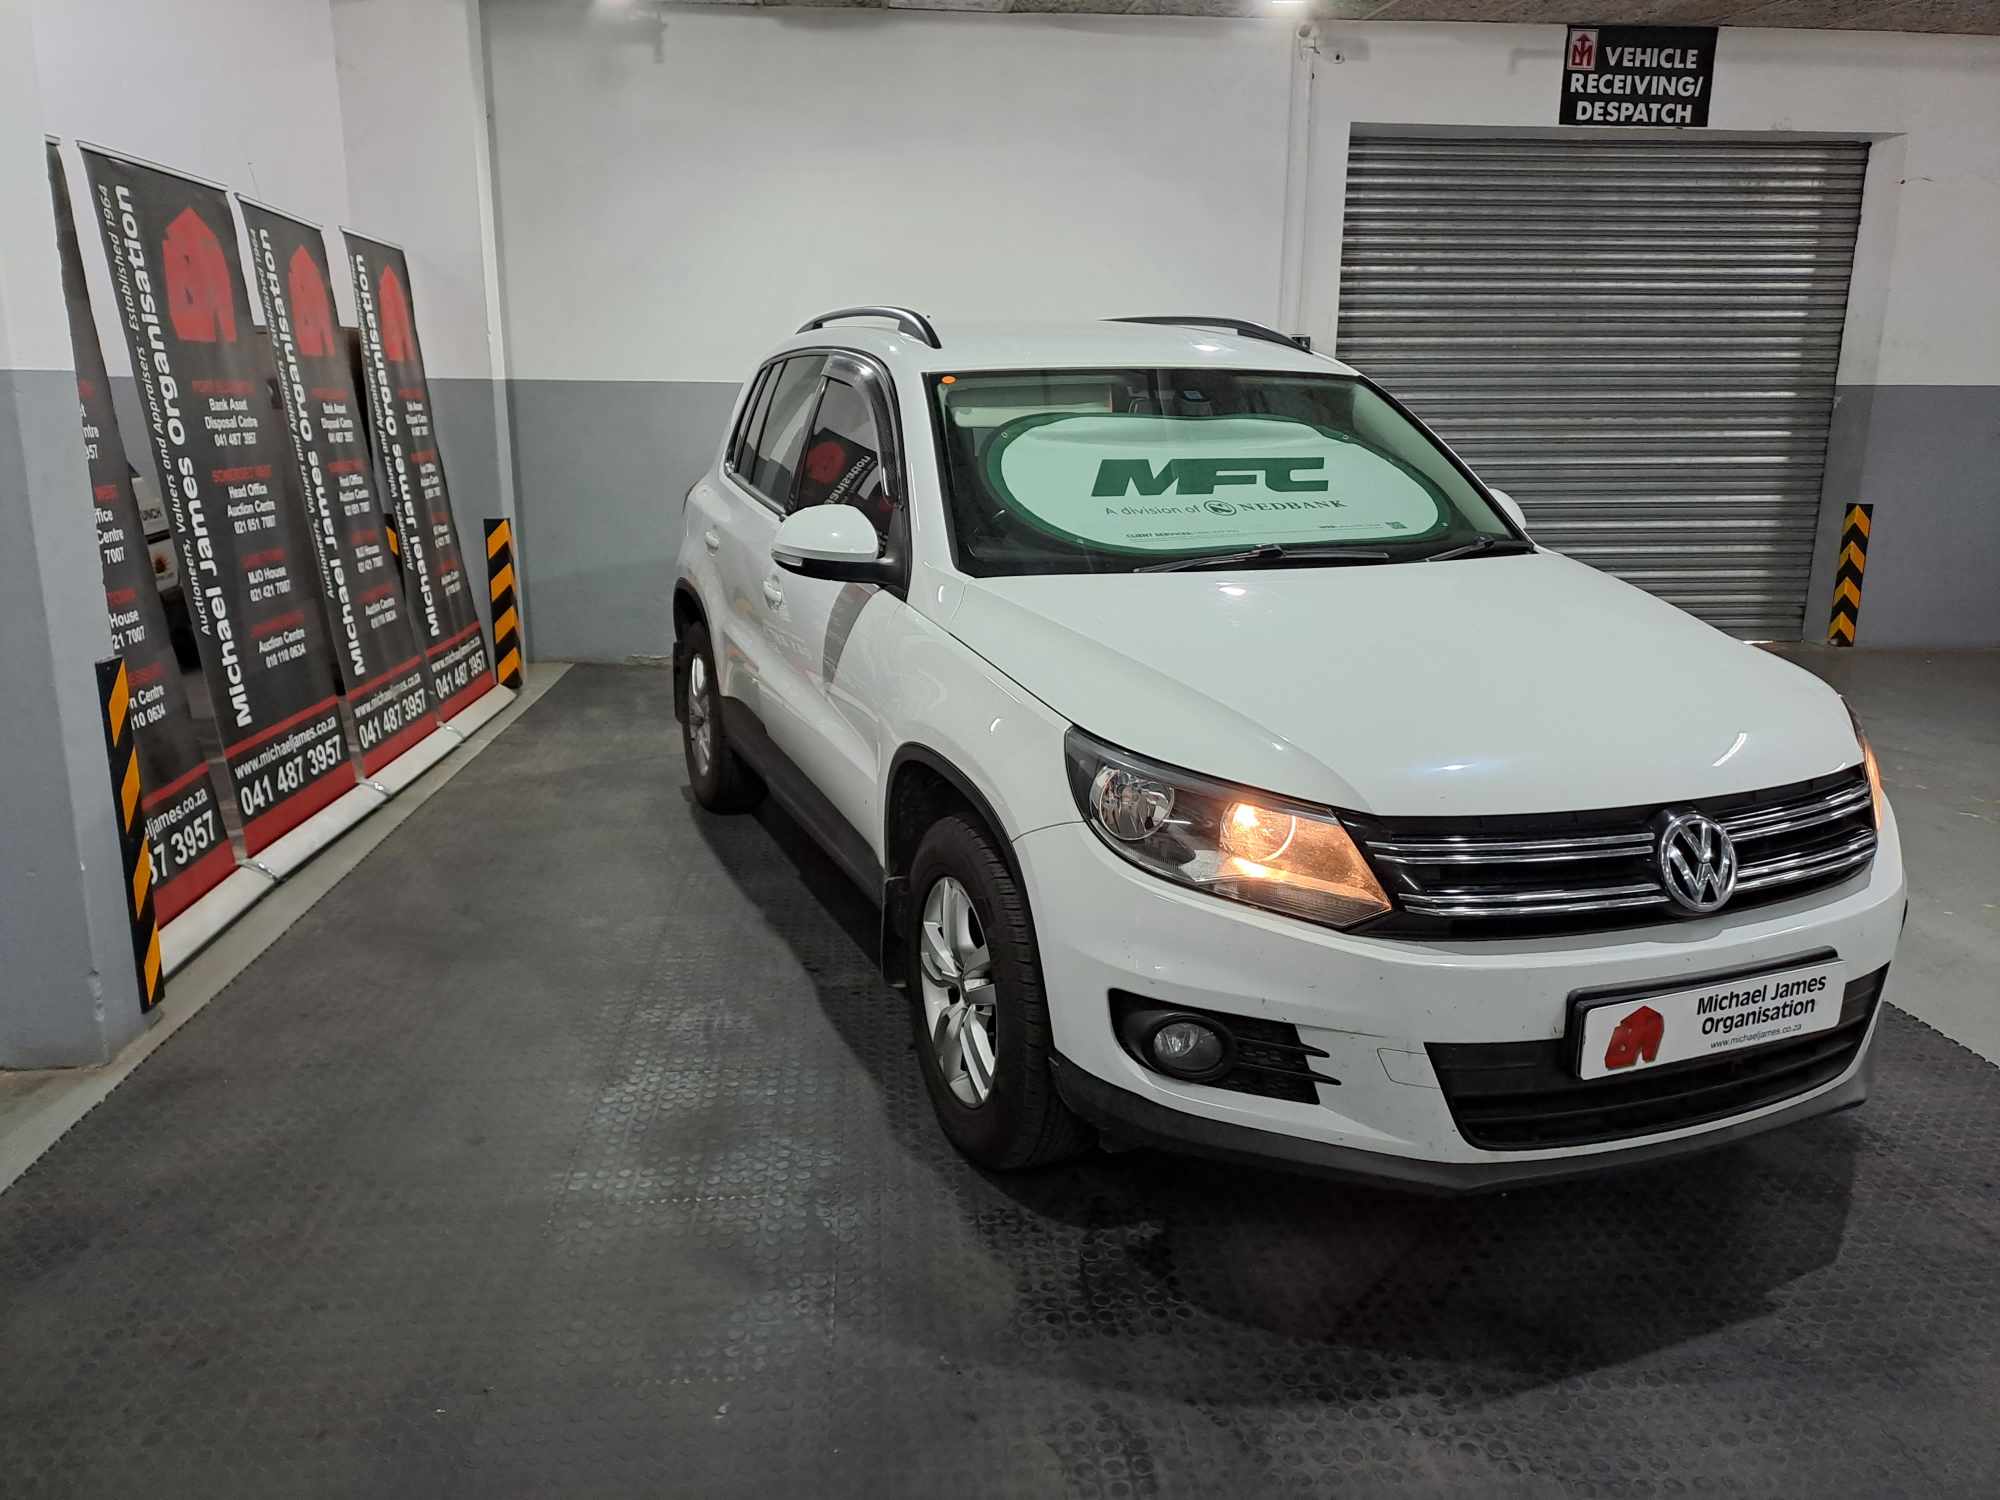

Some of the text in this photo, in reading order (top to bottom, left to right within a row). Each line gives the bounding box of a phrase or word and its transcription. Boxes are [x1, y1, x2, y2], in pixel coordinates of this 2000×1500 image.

[1605, 46, 1699, 69] VEHICLE
[1570, 73, 1704, 97] RECEIVING/
[1575, 101, 1693, 124] DESPATCH
[108, 231, 140, 331] Established
[259, 229, 312, 442] Organisation
[356, 254, 397, 436] Organisation
[137, 347, 165, 434] Appraisers
[83, 424, 99, 438] ntre
[115, 185, 252, 727] Michael James Organisation
[156, 437, 172, 470] and
[392, 443, 417, 529] James
[1091, 457, 1329, 496] MFC
[167, 474, 187, 533] Valuers
[307, 450, 338, 551] James
[1105, 507, 1117, 516] A
[1120, 505, 1183, 516] division
[1184, 504, 1201, 514] of
[1239, 500, 1347, 512] NEDBANK
[97, 528, 124, 544] Centre
[104, 547, 124, 564] 7007
[409, 536, 440, 637] Michael
[109, 610, 140, 628] House
[328, 558, 366, 676] Michael
[111, 625, 145, 649] 21 7007
[138, 685, 165, 705] Centre
[435, 672, 454, 699] 041
[454, 662, 469, 689] 487
[359, 688, 427, 749] 041 487 3957
[234, 716, 337, 780] www.michaeljames.co.za
[240, 734, 342, 816] 041 487 3957
[171, 810, 215, 865] 3957
[1697, 976, 1827, 1015] Michael James
[1702, 998, 1816, 1035] Organisation
